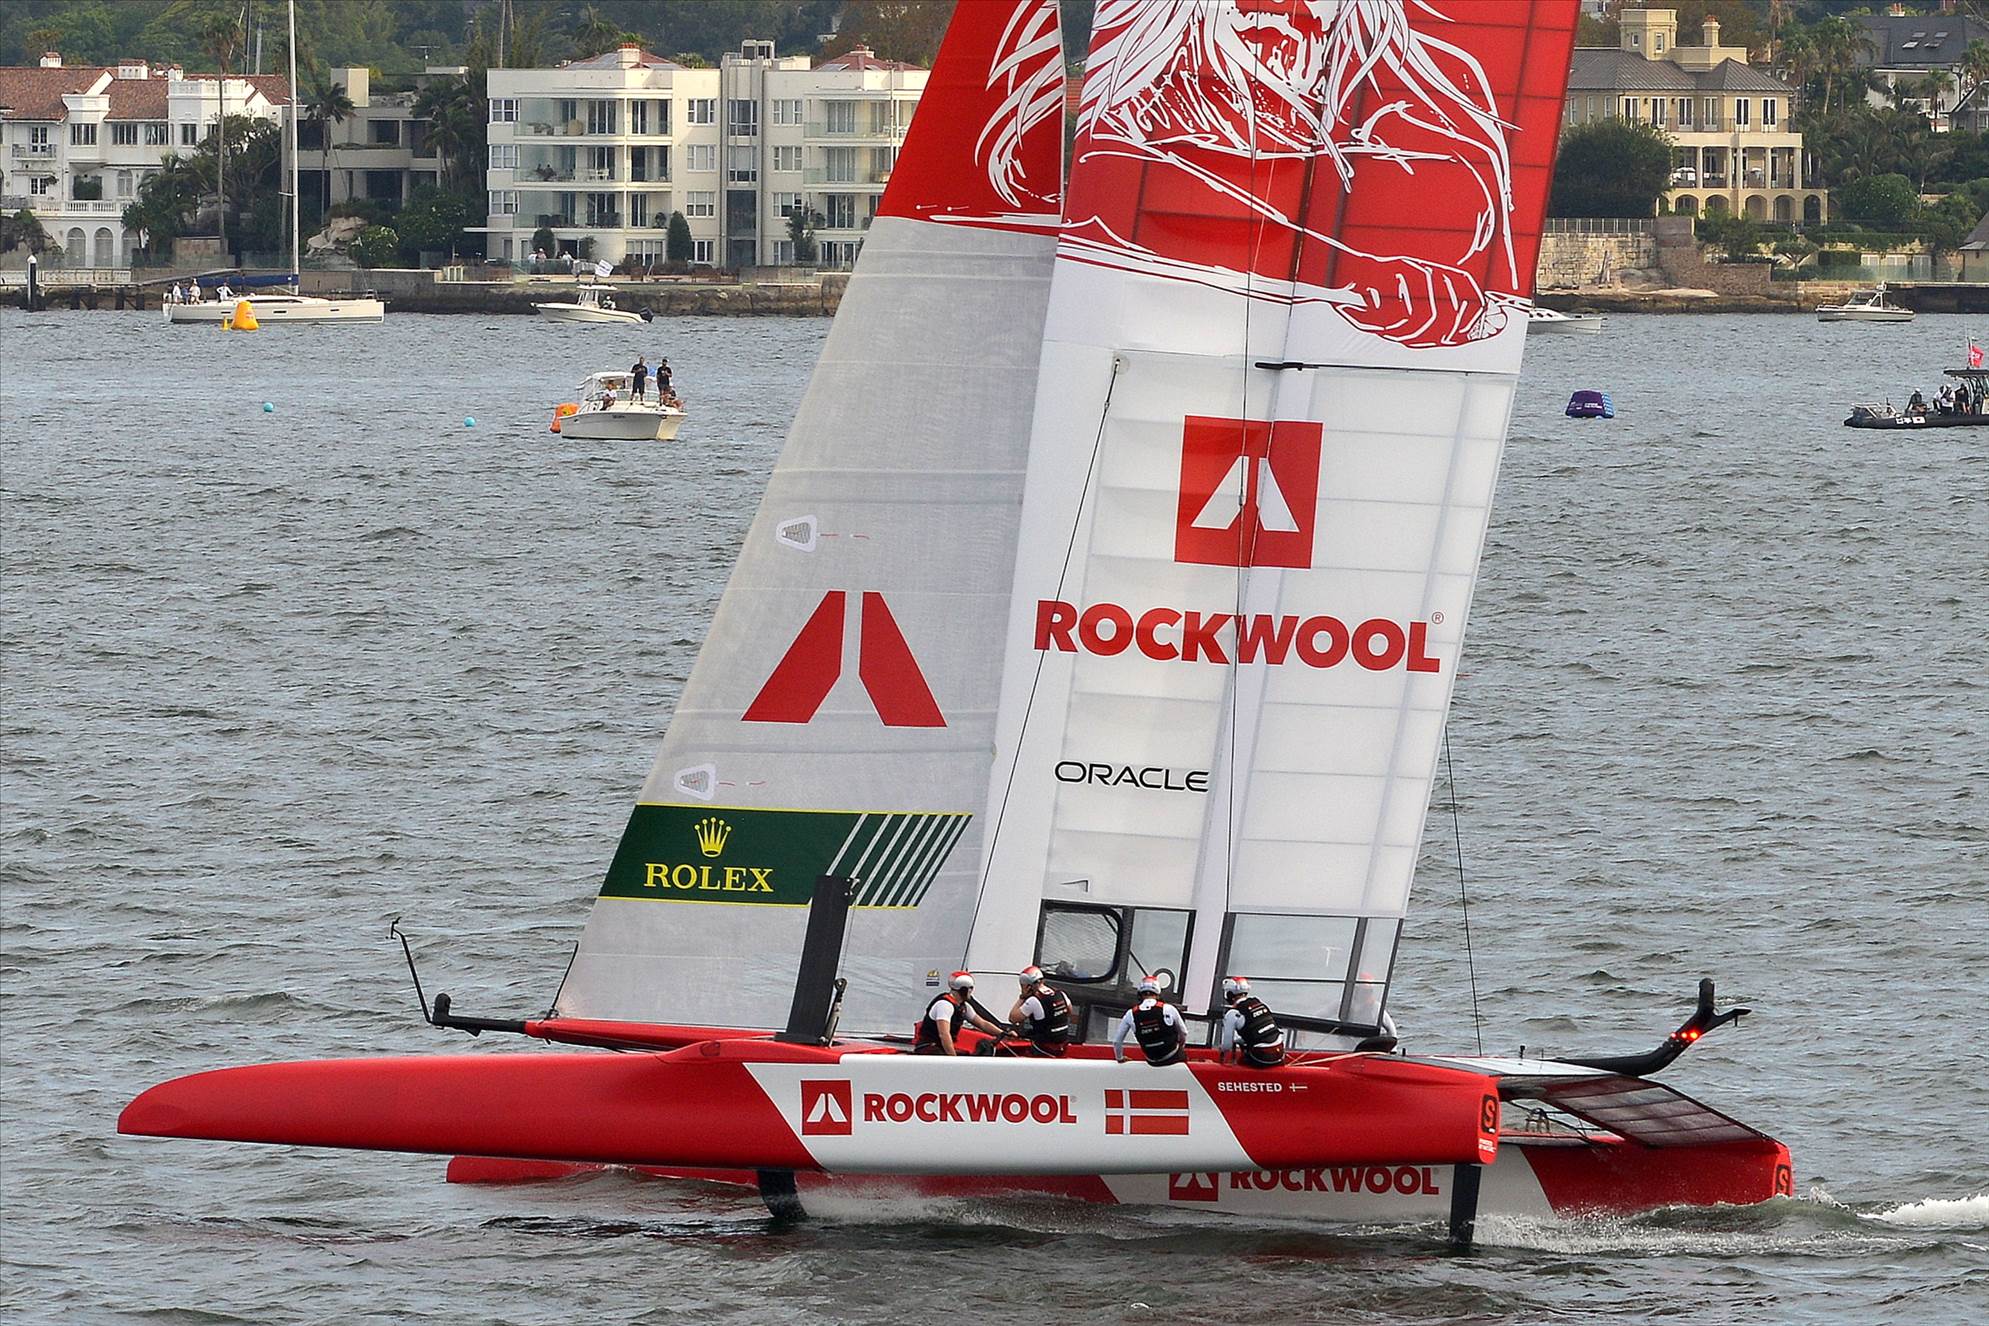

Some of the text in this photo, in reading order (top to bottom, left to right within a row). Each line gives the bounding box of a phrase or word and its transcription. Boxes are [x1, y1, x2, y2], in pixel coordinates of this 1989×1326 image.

[1054, 760, 1209, 793] ORACLE
[644, 862, 775, 894] ROLEX
[1217, 1081, 1283, 1093] SEHESTED
